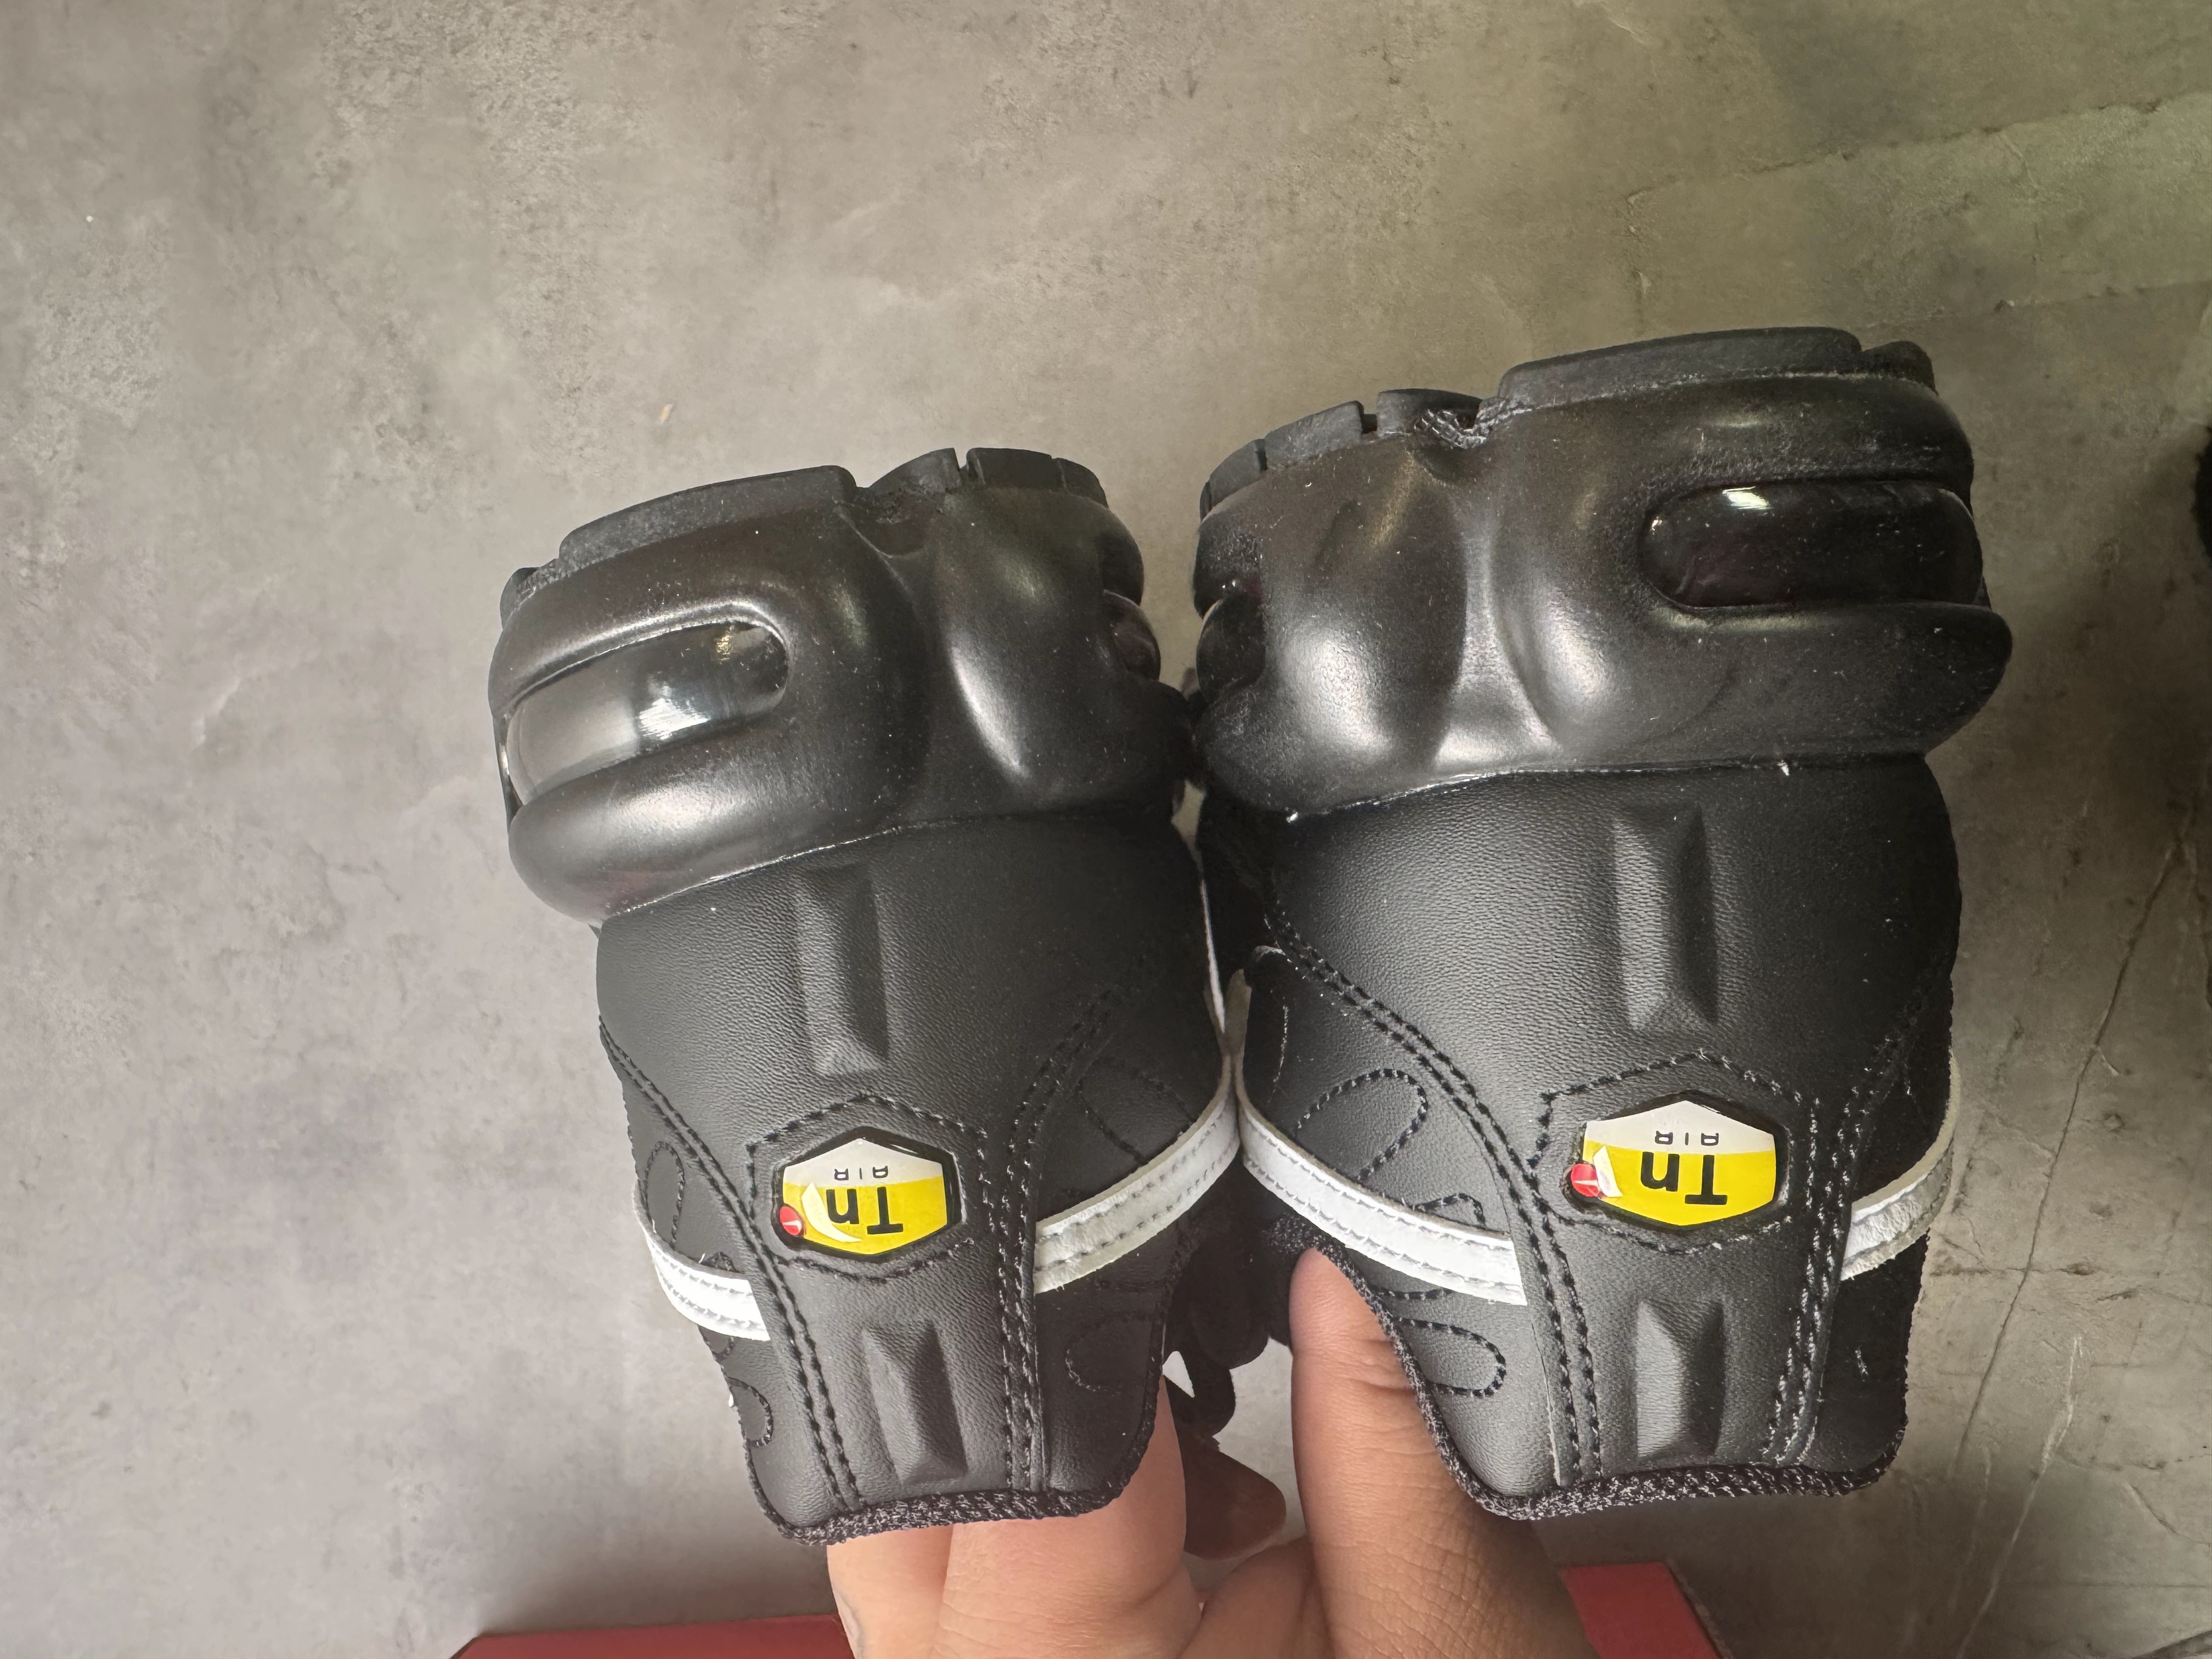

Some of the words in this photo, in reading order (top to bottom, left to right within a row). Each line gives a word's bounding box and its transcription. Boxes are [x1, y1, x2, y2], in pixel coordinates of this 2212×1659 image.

[1654, 1130, 1719, 1146] AIR
[834, 1165, 889, 1181] AIR
[1640, 1151, 1728, 1205] Tn
[825, 1186, 904, 1235] Tn
